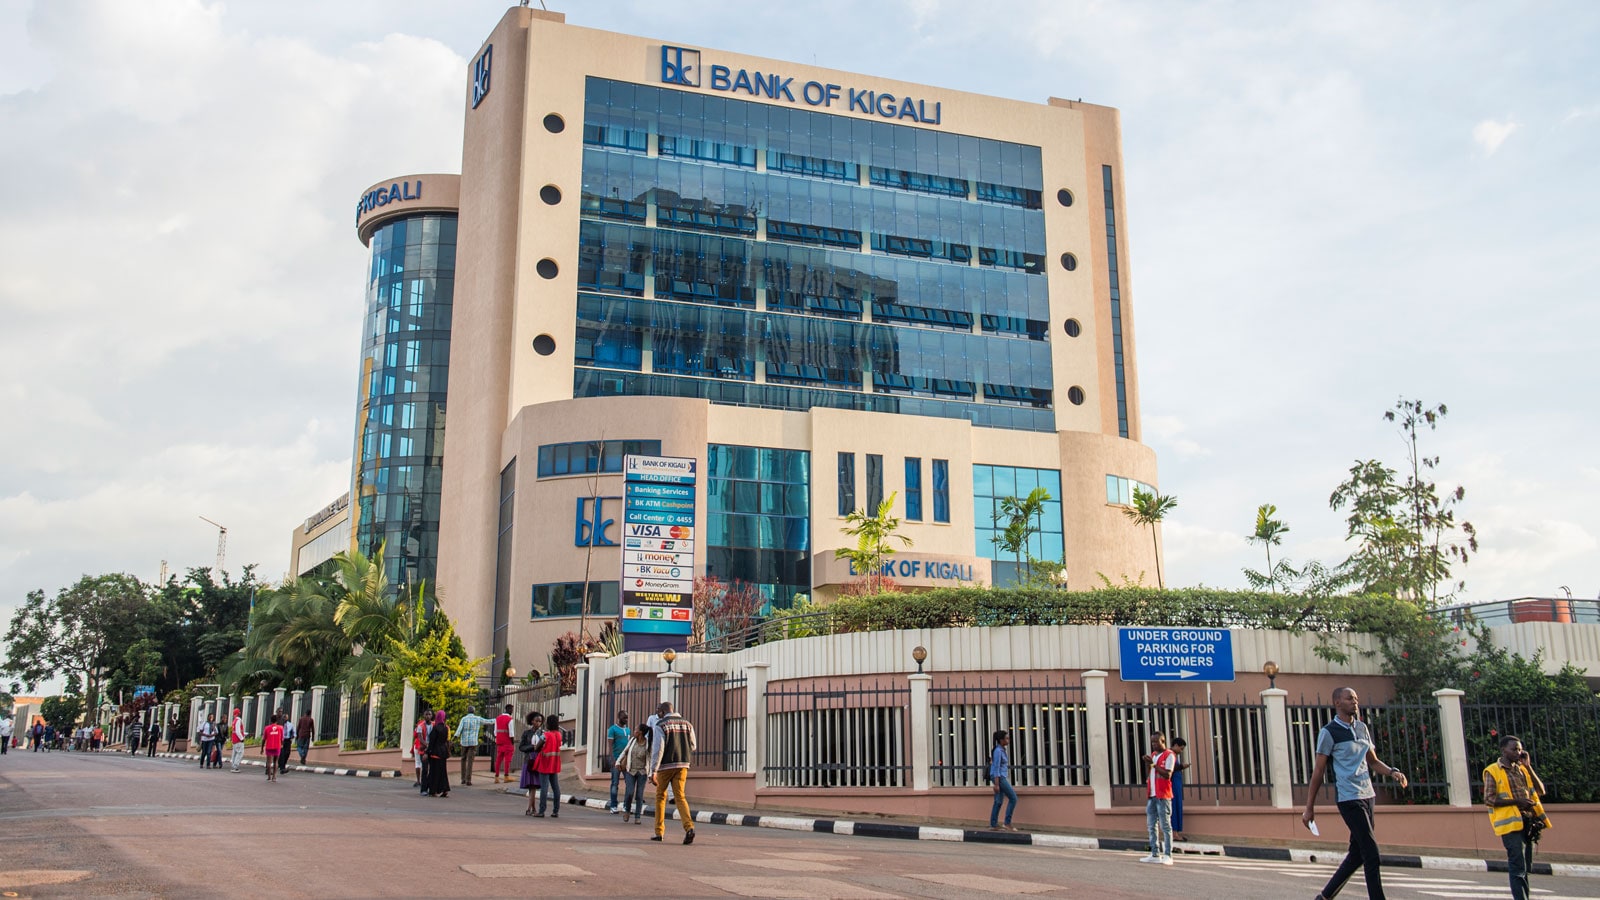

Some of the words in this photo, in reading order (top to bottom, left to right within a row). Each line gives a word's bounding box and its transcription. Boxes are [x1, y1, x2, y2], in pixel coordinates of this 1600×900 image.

[711, 65, 795, 102] BANK
[803, 81, 841, 106] OF
[850, 87, 941, 125] KIGALI
[363, 180, 422, 214] KIGALI
[635, 486, 661, 495] Banking
[662, 488, 689, 496] Services
[631, 525, 661, 536] VISA
[645, 553, 675, 563] money
[900, 560, 920, 577] OF
[925, 561, 973, 581] KIGALI
[1128, 630, 1169, 640] UNDER
[1172, 631, 1223, 641] GROUND
[1137, 643, 1189, 654] PARKING
[1191, 644, 1215, 654] FOR
[1140, 656, 1214, 667] CUSTOMERS
